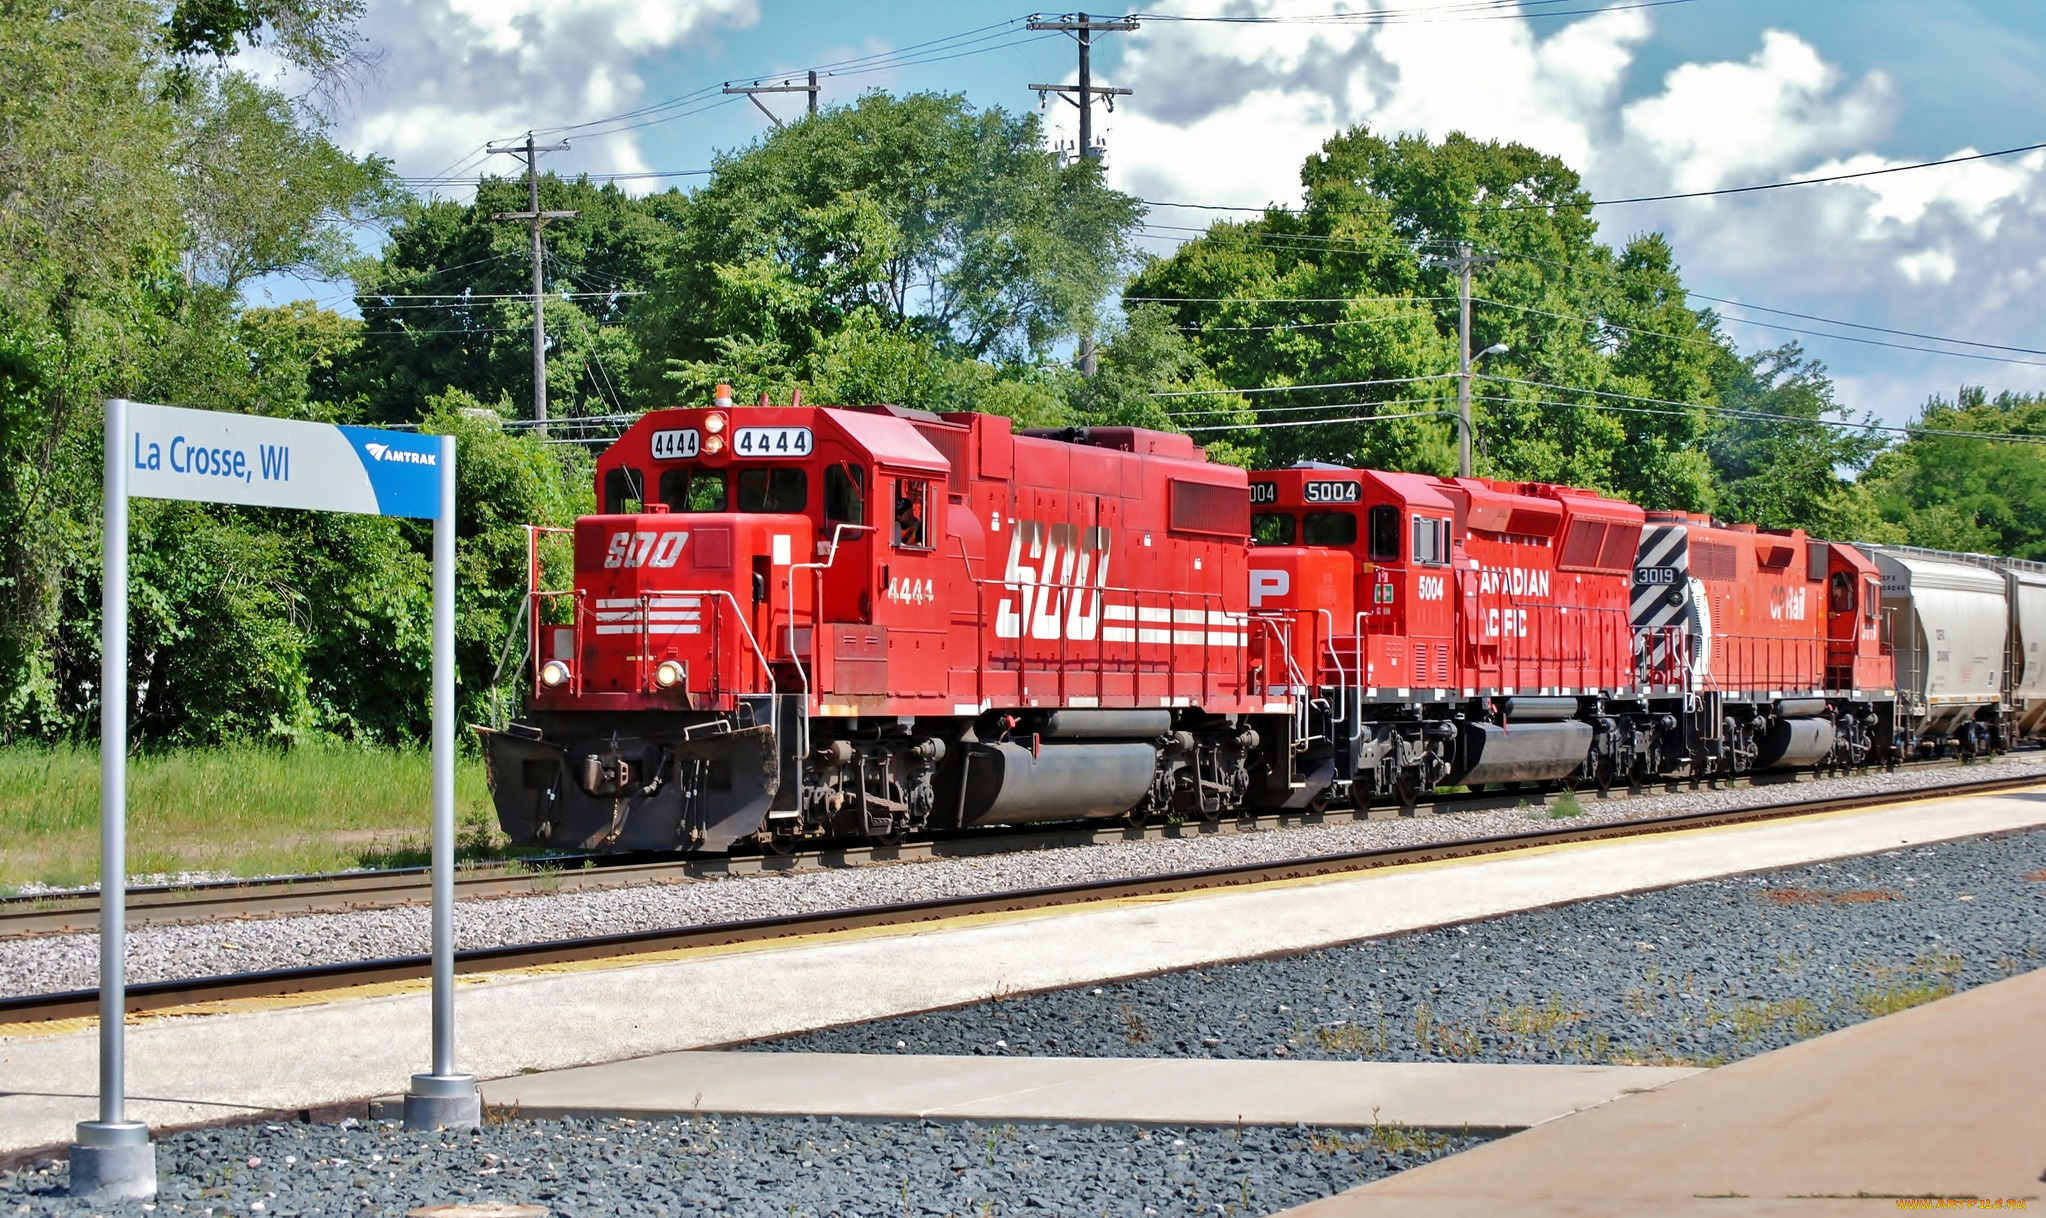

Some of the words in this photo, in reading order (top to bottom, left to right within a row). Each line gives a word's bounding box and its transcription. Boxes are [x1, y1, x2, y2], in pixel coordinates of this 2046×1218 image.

[655, 433, 696, 456] 4444
[740, 431, 806, 453] 4444
[134, 432, 161, 471] La
[169, 435, 252, 484] Crosse,
[259, 444, 289, 482] WI
[384, 449, 436, 466] AMTRAK
[1250, 484, 1275, 502] 004
[1308, 483, 1357, 501] 5004
[603, 531, 689, 569] SOO
[995, 519, 1111, 640] SOO
[1638, 568, 1674, 583] 3019
[887, 577, 934, 606] 4444
[1249, 569, 1290, 608] P
[1418, 576, 1444, 601] 5004
[1770, 585, 1785, 620] CP
[1785, 586, 1805, 621] Rail
